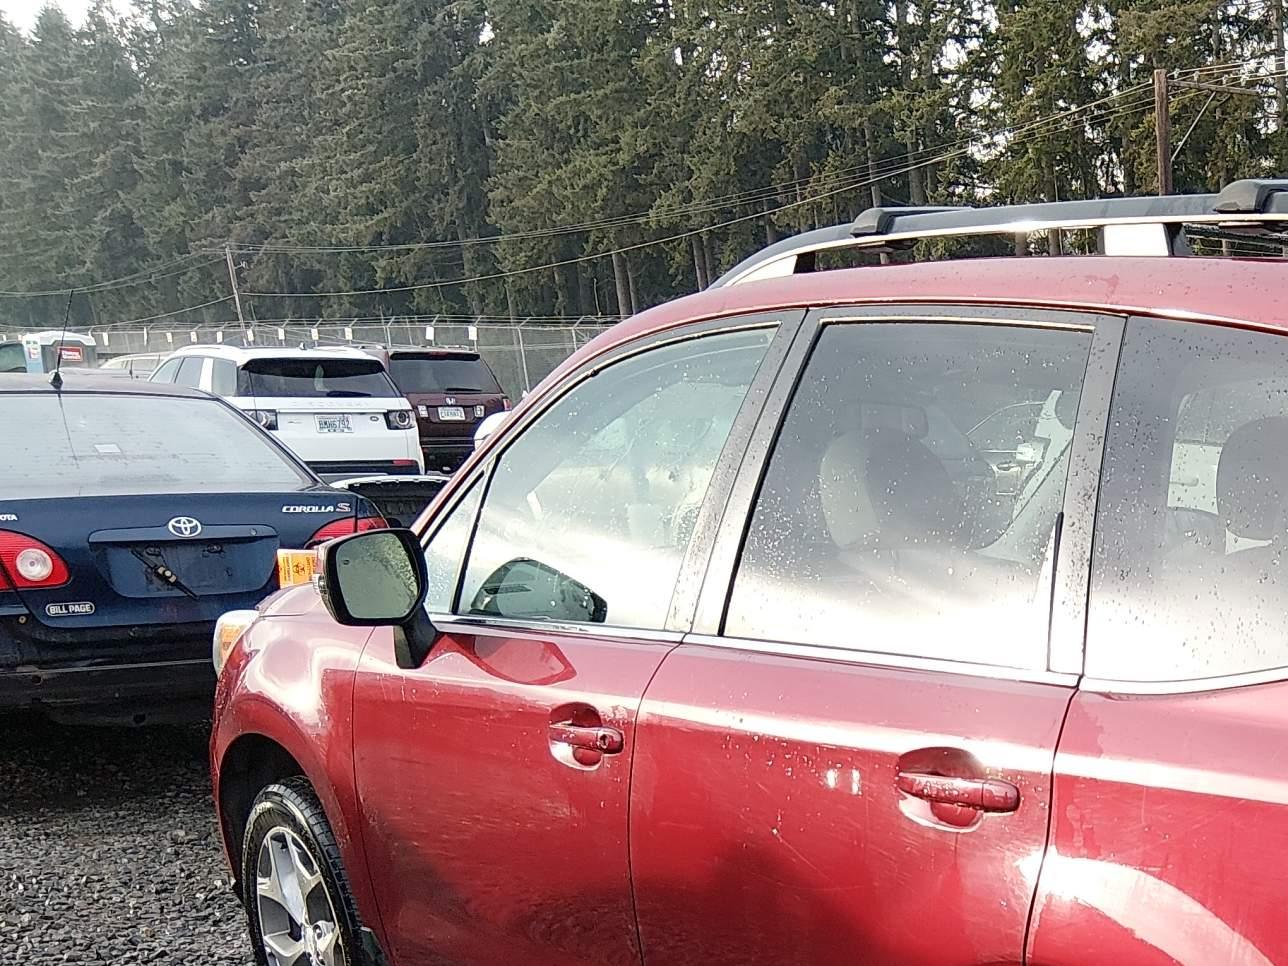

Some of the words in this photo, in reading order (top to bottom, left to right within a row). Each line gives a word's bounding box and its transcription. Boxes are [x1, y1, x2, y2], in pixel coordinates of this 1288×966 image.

[282, 505, 334, 513] COROLLA
[335, 502, 351, 512] S
[49, 605, 68, 614] BILL
[69, 604, 91, 613] PAGE
